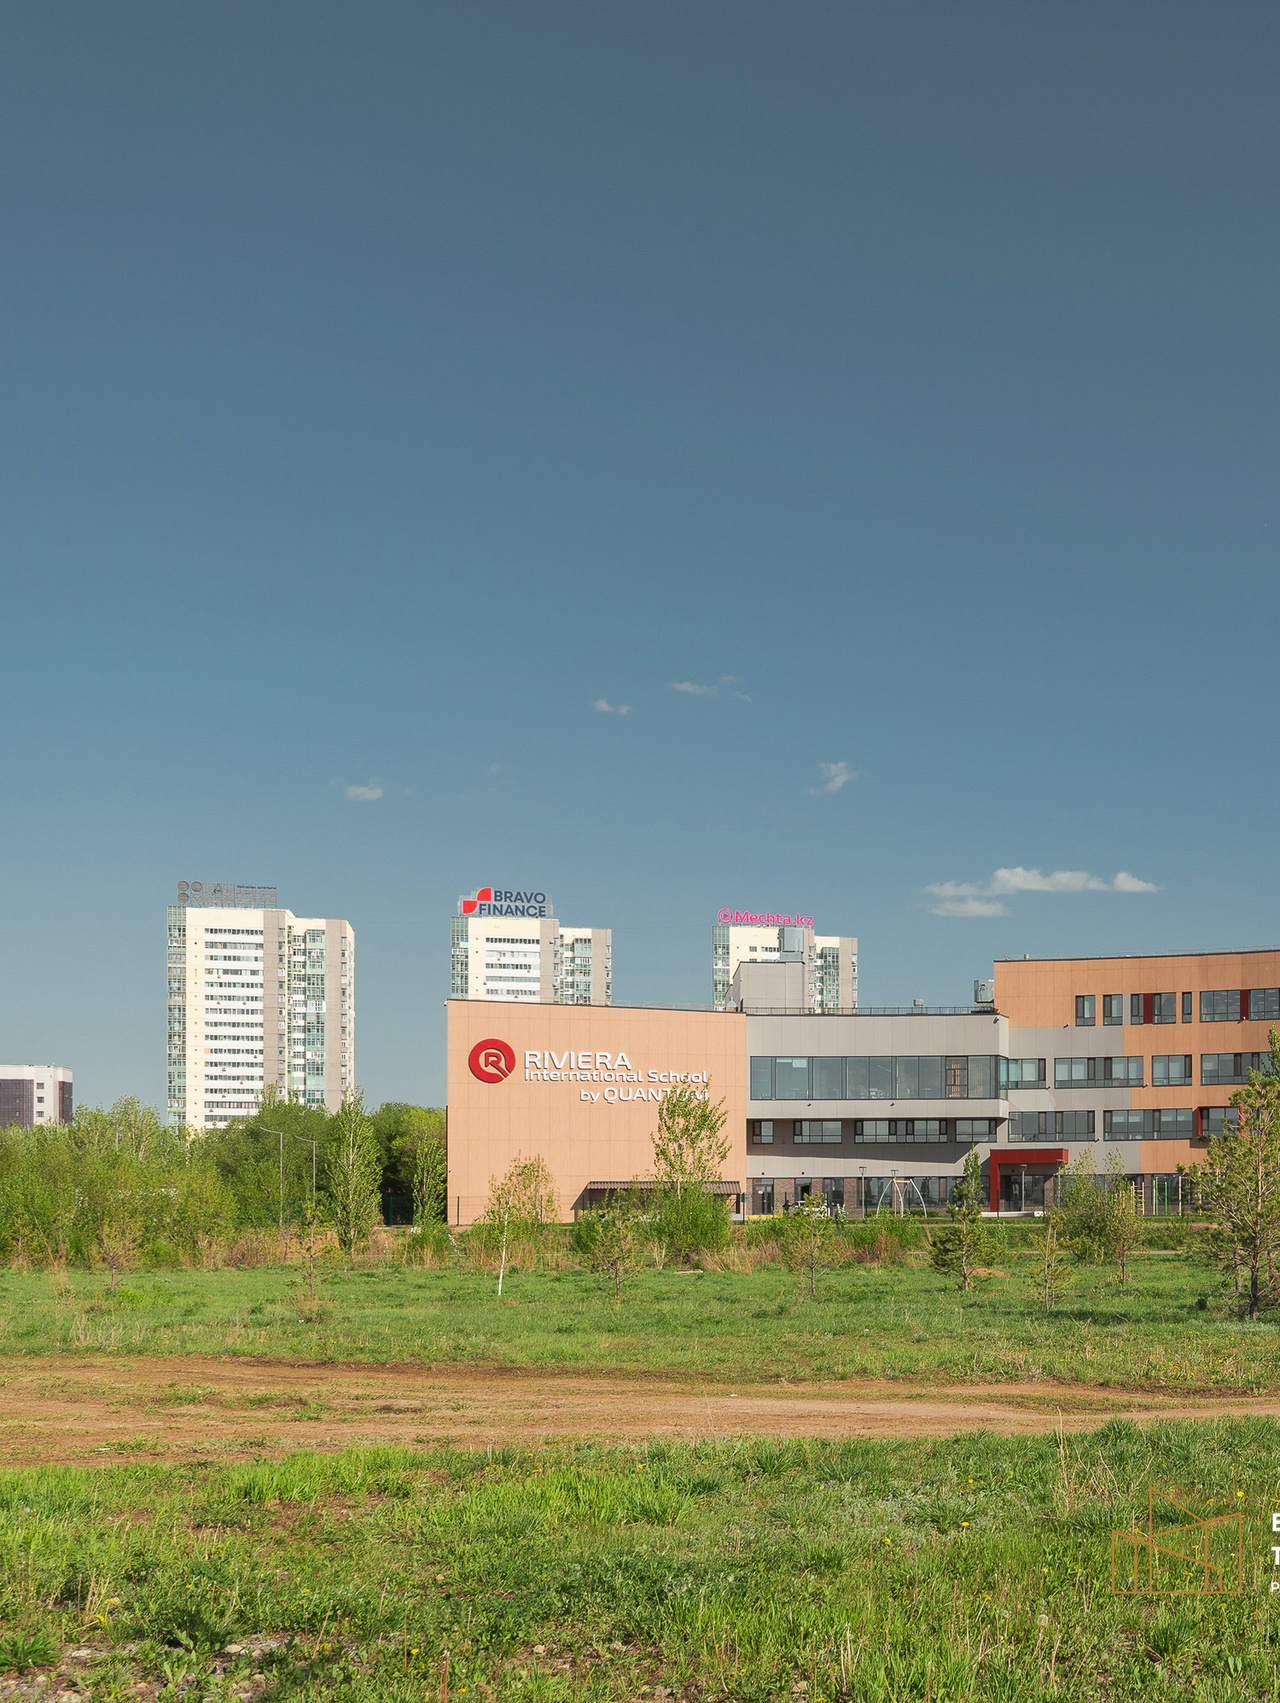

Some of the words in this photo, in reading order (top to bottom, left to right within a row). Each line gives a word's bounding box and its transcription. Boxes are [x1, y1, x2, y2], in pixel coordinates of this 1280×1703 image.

[494, 890, 546, 904] BRAVO
[479, 903, 546, 917] FINANCE
[735, 910, 814, 926] Mechta.kz
[524, 1051, 632, 1070] RIVIERA
[524, 1069, 643, 1083] International
[648, 1069, 708, 1084] School
[580, 1089, 600, 1103] by
